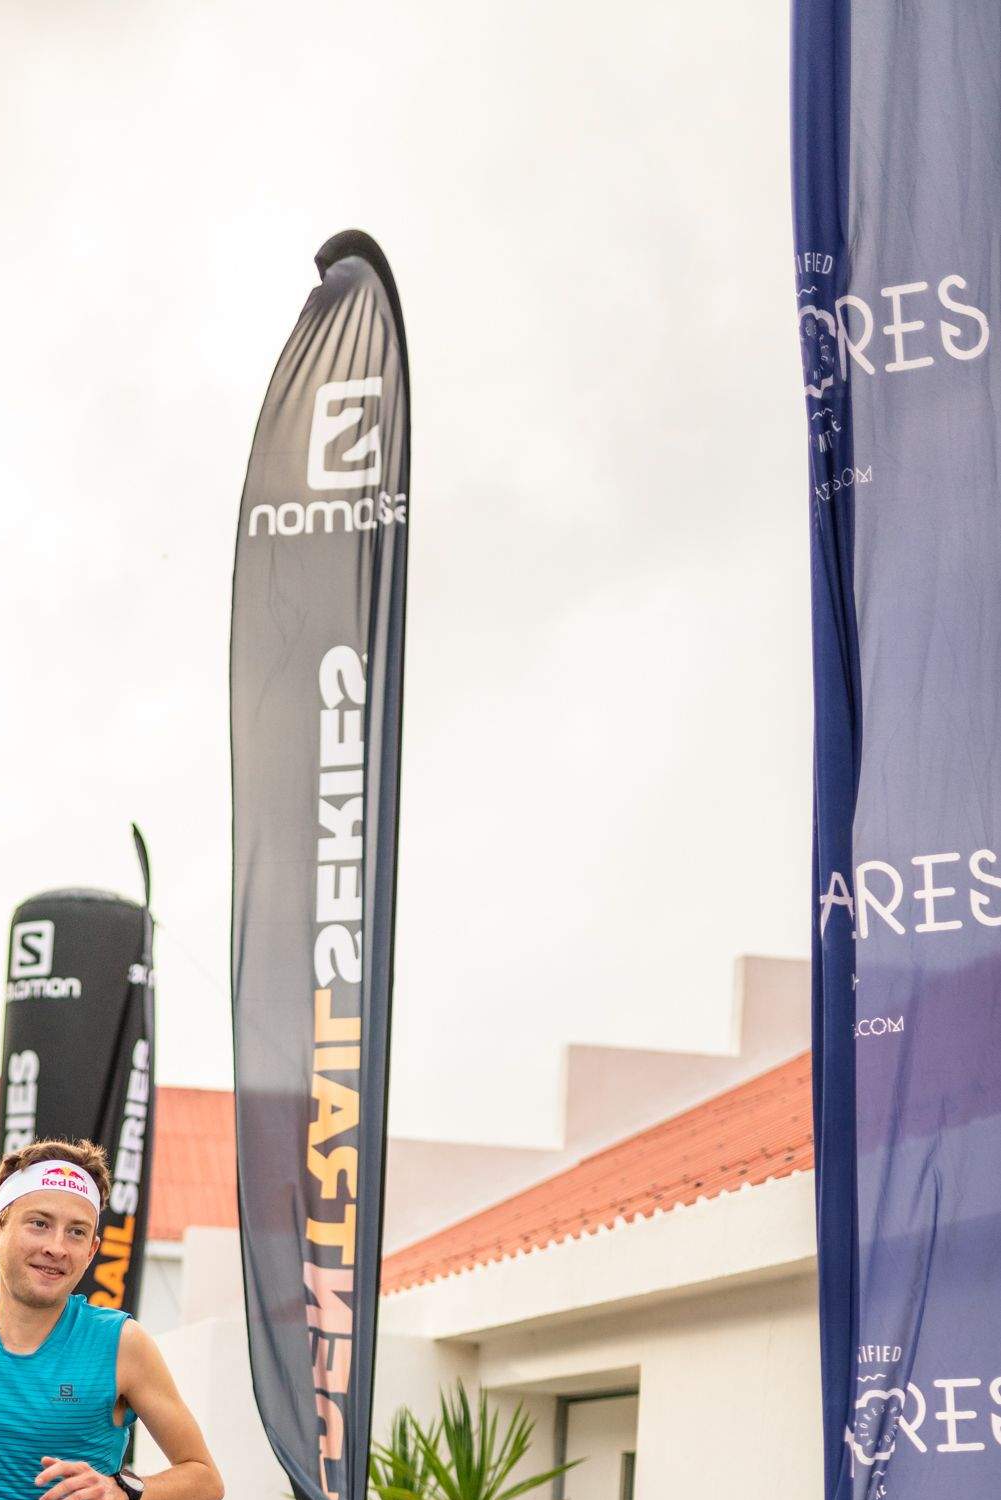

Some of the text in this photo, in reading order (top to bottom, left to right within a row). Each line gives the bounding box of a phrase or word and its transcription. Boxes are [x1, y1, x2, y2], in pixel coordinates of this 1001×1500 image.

[4, 1049, 40, 1155] RIES
[41, 1178, 89, 1195] Red Bull
